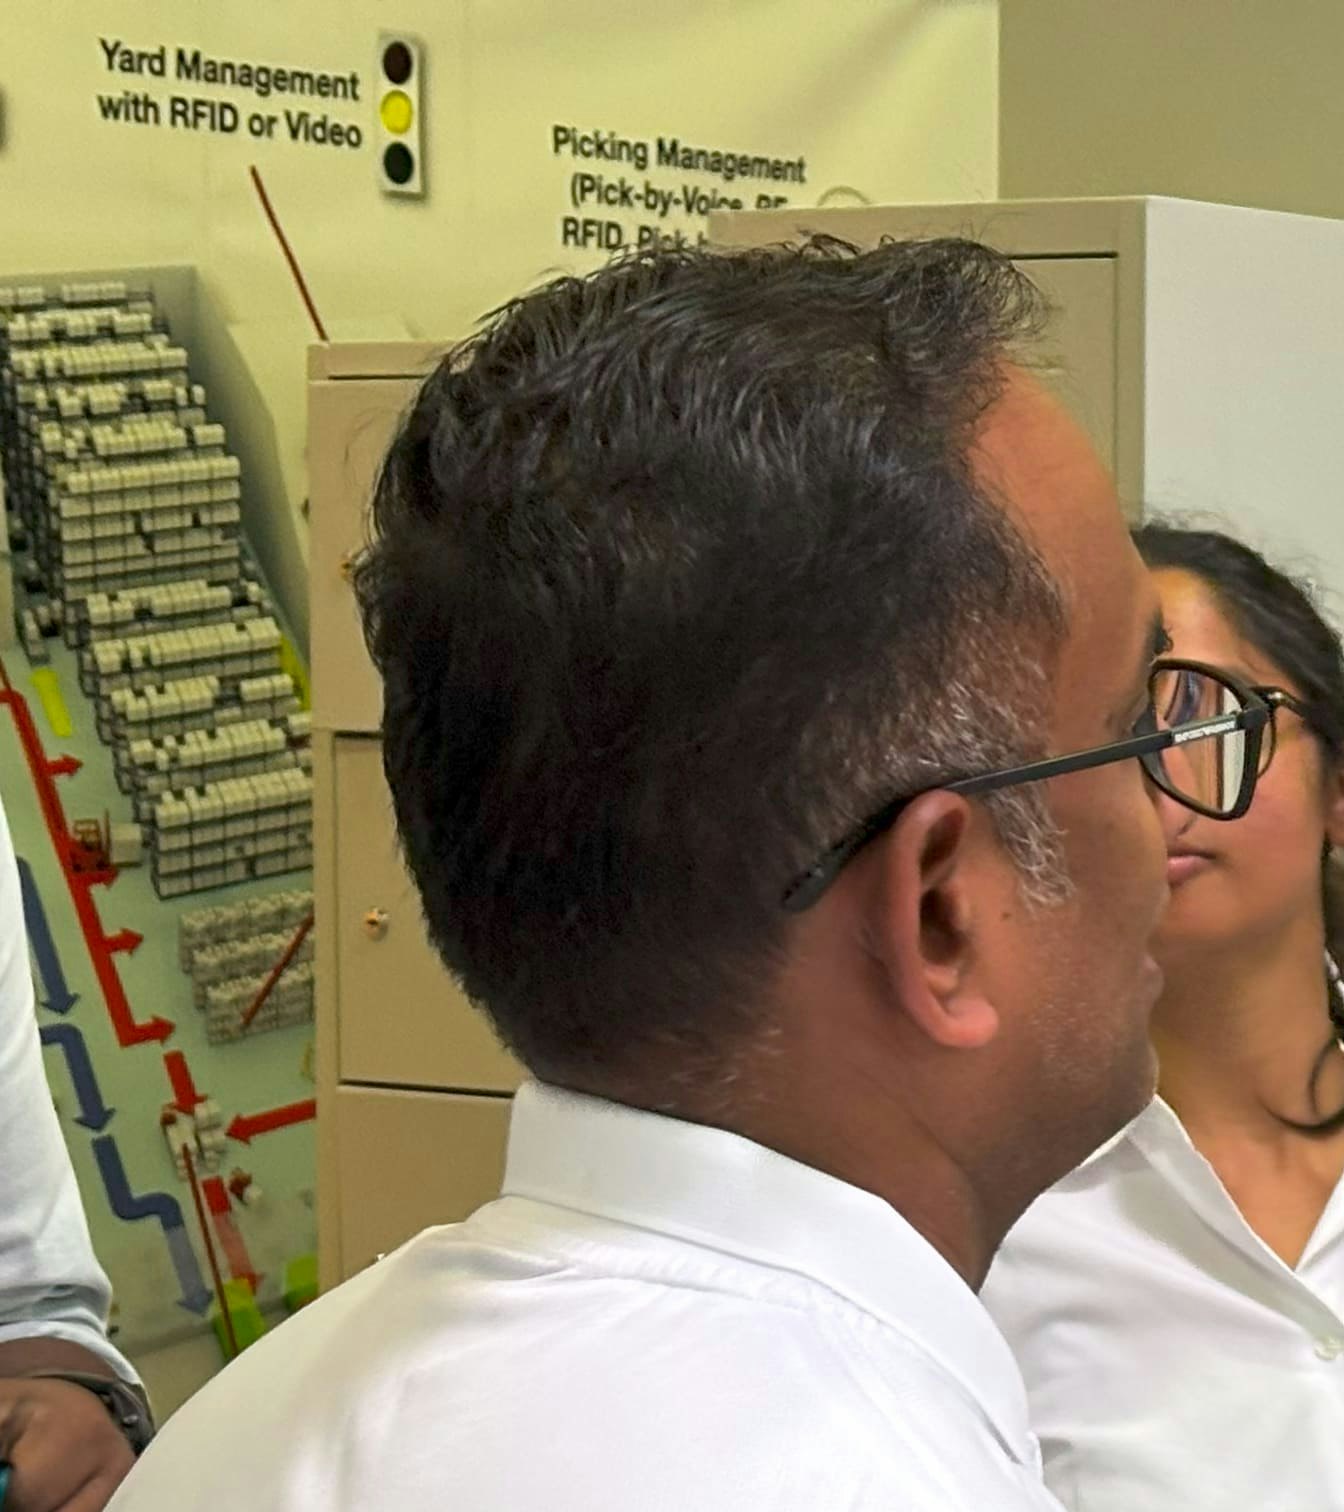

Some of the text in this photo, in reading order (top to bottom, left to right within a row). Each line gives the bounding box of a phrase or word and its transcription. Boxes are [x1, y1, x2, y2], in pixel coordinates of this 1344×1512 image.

[99, 37, 360, 101] Yard Management
[97, 92, 361, 148] with RFID or Video
[552, 125, 806, 183] Picking Management
